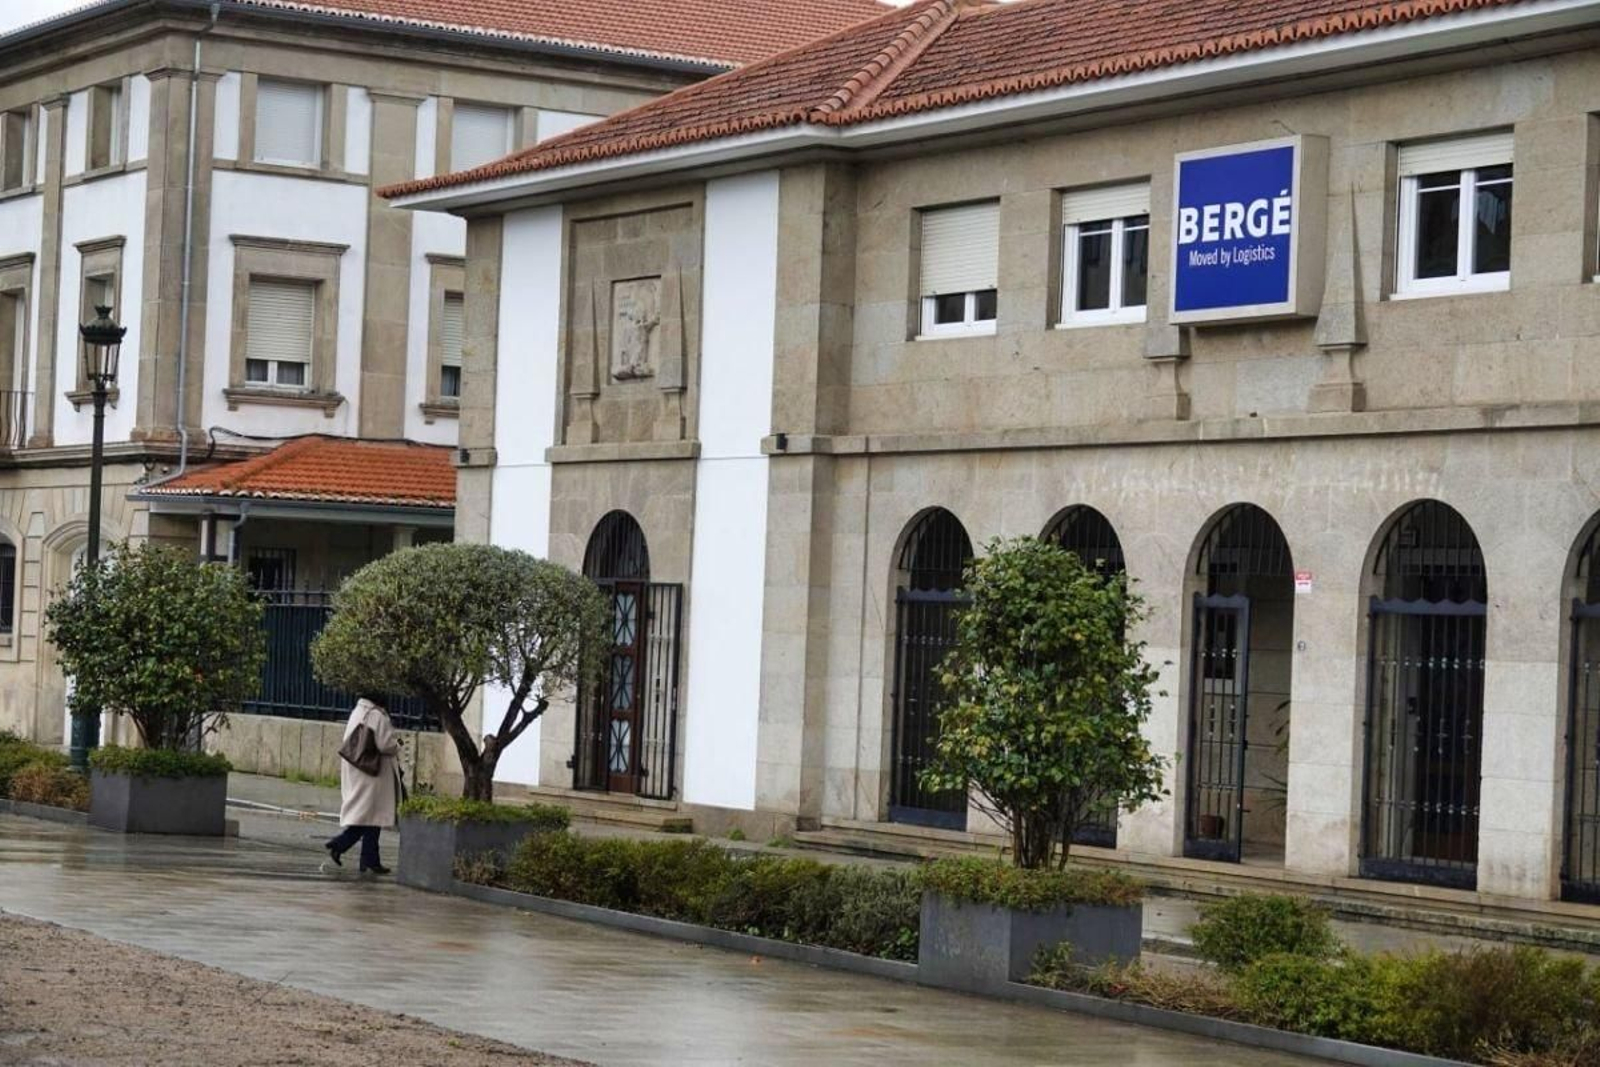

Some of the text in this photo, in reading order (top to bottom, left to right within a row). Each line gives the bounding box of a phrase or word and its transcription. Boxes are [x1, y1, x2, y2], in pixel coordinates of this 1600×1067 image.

[1178, 189, 1291, 244] BERGÉ
[1188, 243, 1275, 268] Moved by Logistics
